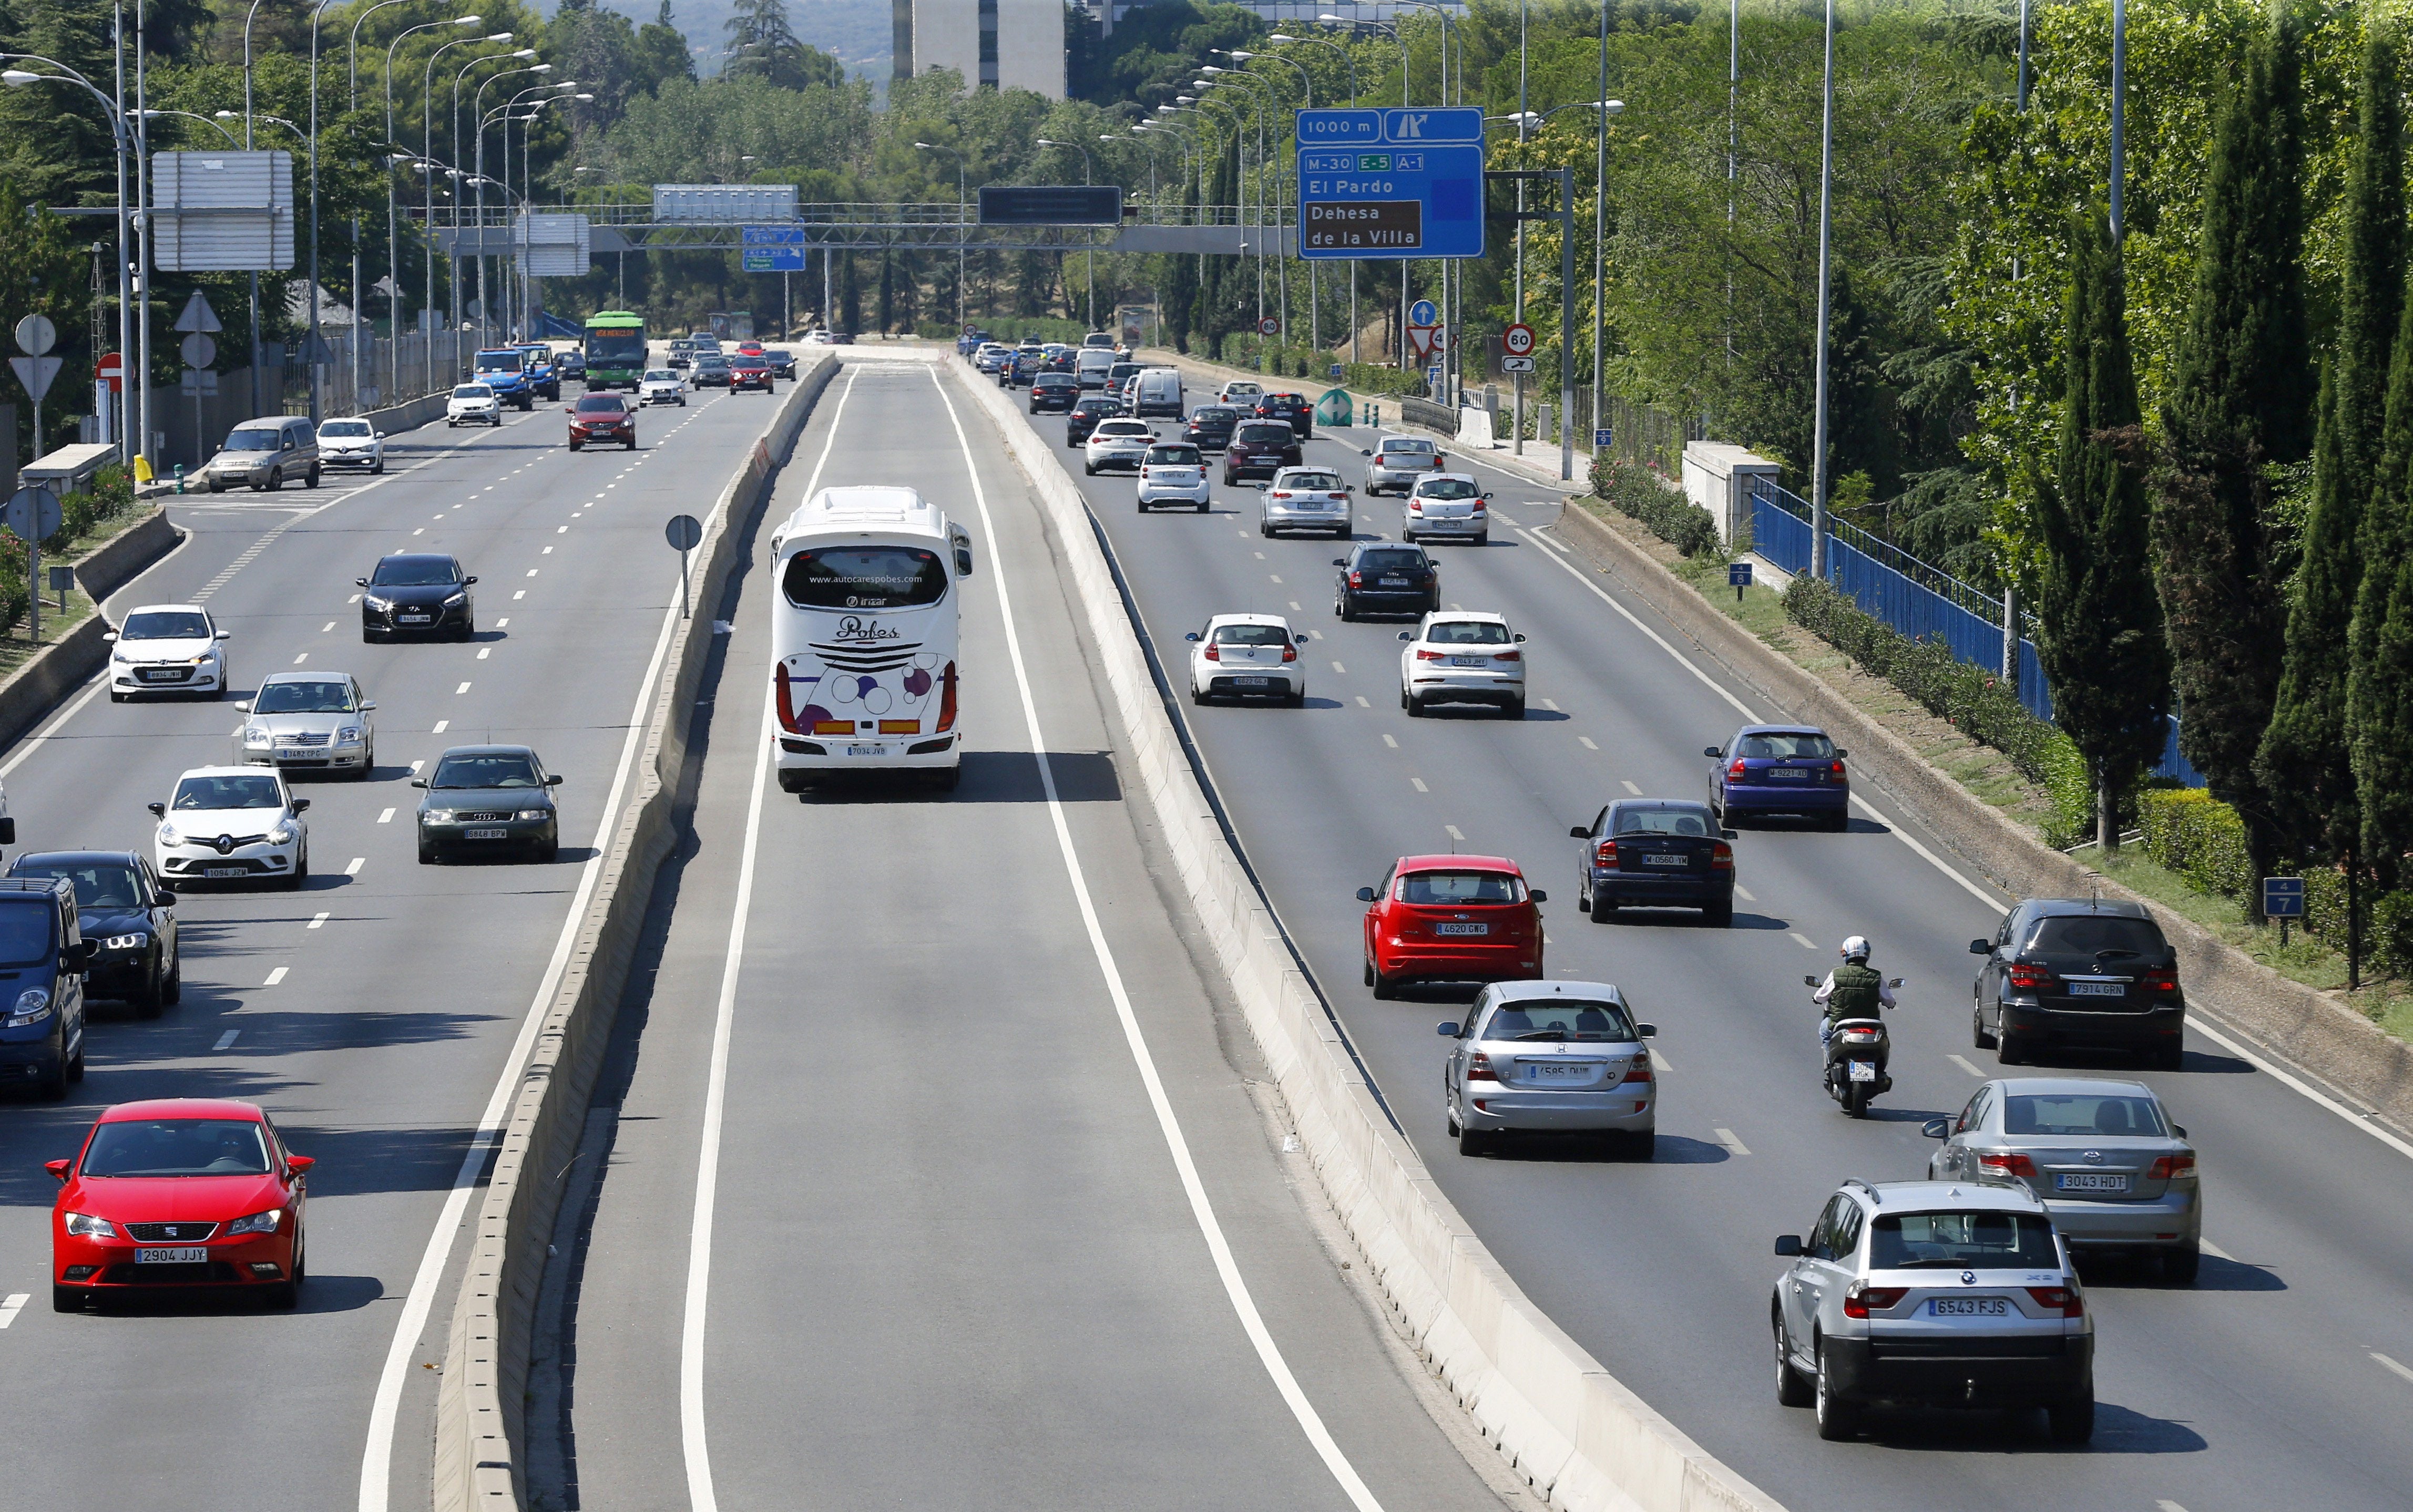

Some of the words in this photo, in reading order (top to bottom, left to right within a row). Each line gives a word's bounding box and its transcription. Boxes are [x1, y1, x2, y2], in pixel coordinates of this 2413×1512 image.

[1308, 121, 1350, 132] 1000
[1358, 122, 1371, 132] m
[1308, 158, 1350, 170] M-30
[1360, 157, 1389, 169] E-5
[1398, 157, 1422, 169] A-1
[1310, 180, 1328, 194] El
[1336, 180, 1393, 194] Pardo
[1311, 206, 1379, 220] Dehesa
[1311, 233, 1334, 245] de
[1343, 231, 1361, 244] la
[1369, 230, 1415, 244] Villa
[1263, 322, 1276, 331] 80
[1511, 334, 1529, 345] 60
[809, 575, 922, 584] www.autocarespobes.com
[1737, 574, 1744, 583] 8
[835, 615, 900, 641] Pobes
[2280, 882, 2288, 891] 4
[2278, 898, 2291, 912] 7
[2076, 984, 2101, 993] 7914
[2103, 985, 2123, 994] GRN
[2066, 1176, 2097, 1187] 3043
[2101, 1176, 2123, 1188] HDT
[143, 1250, 176, 1261] 2904
[180, 1249, 203, 1261] JJY
[1938, 1301, 1974, 1314] 6543
[1979, 1301, 2006, 1314] FJS
